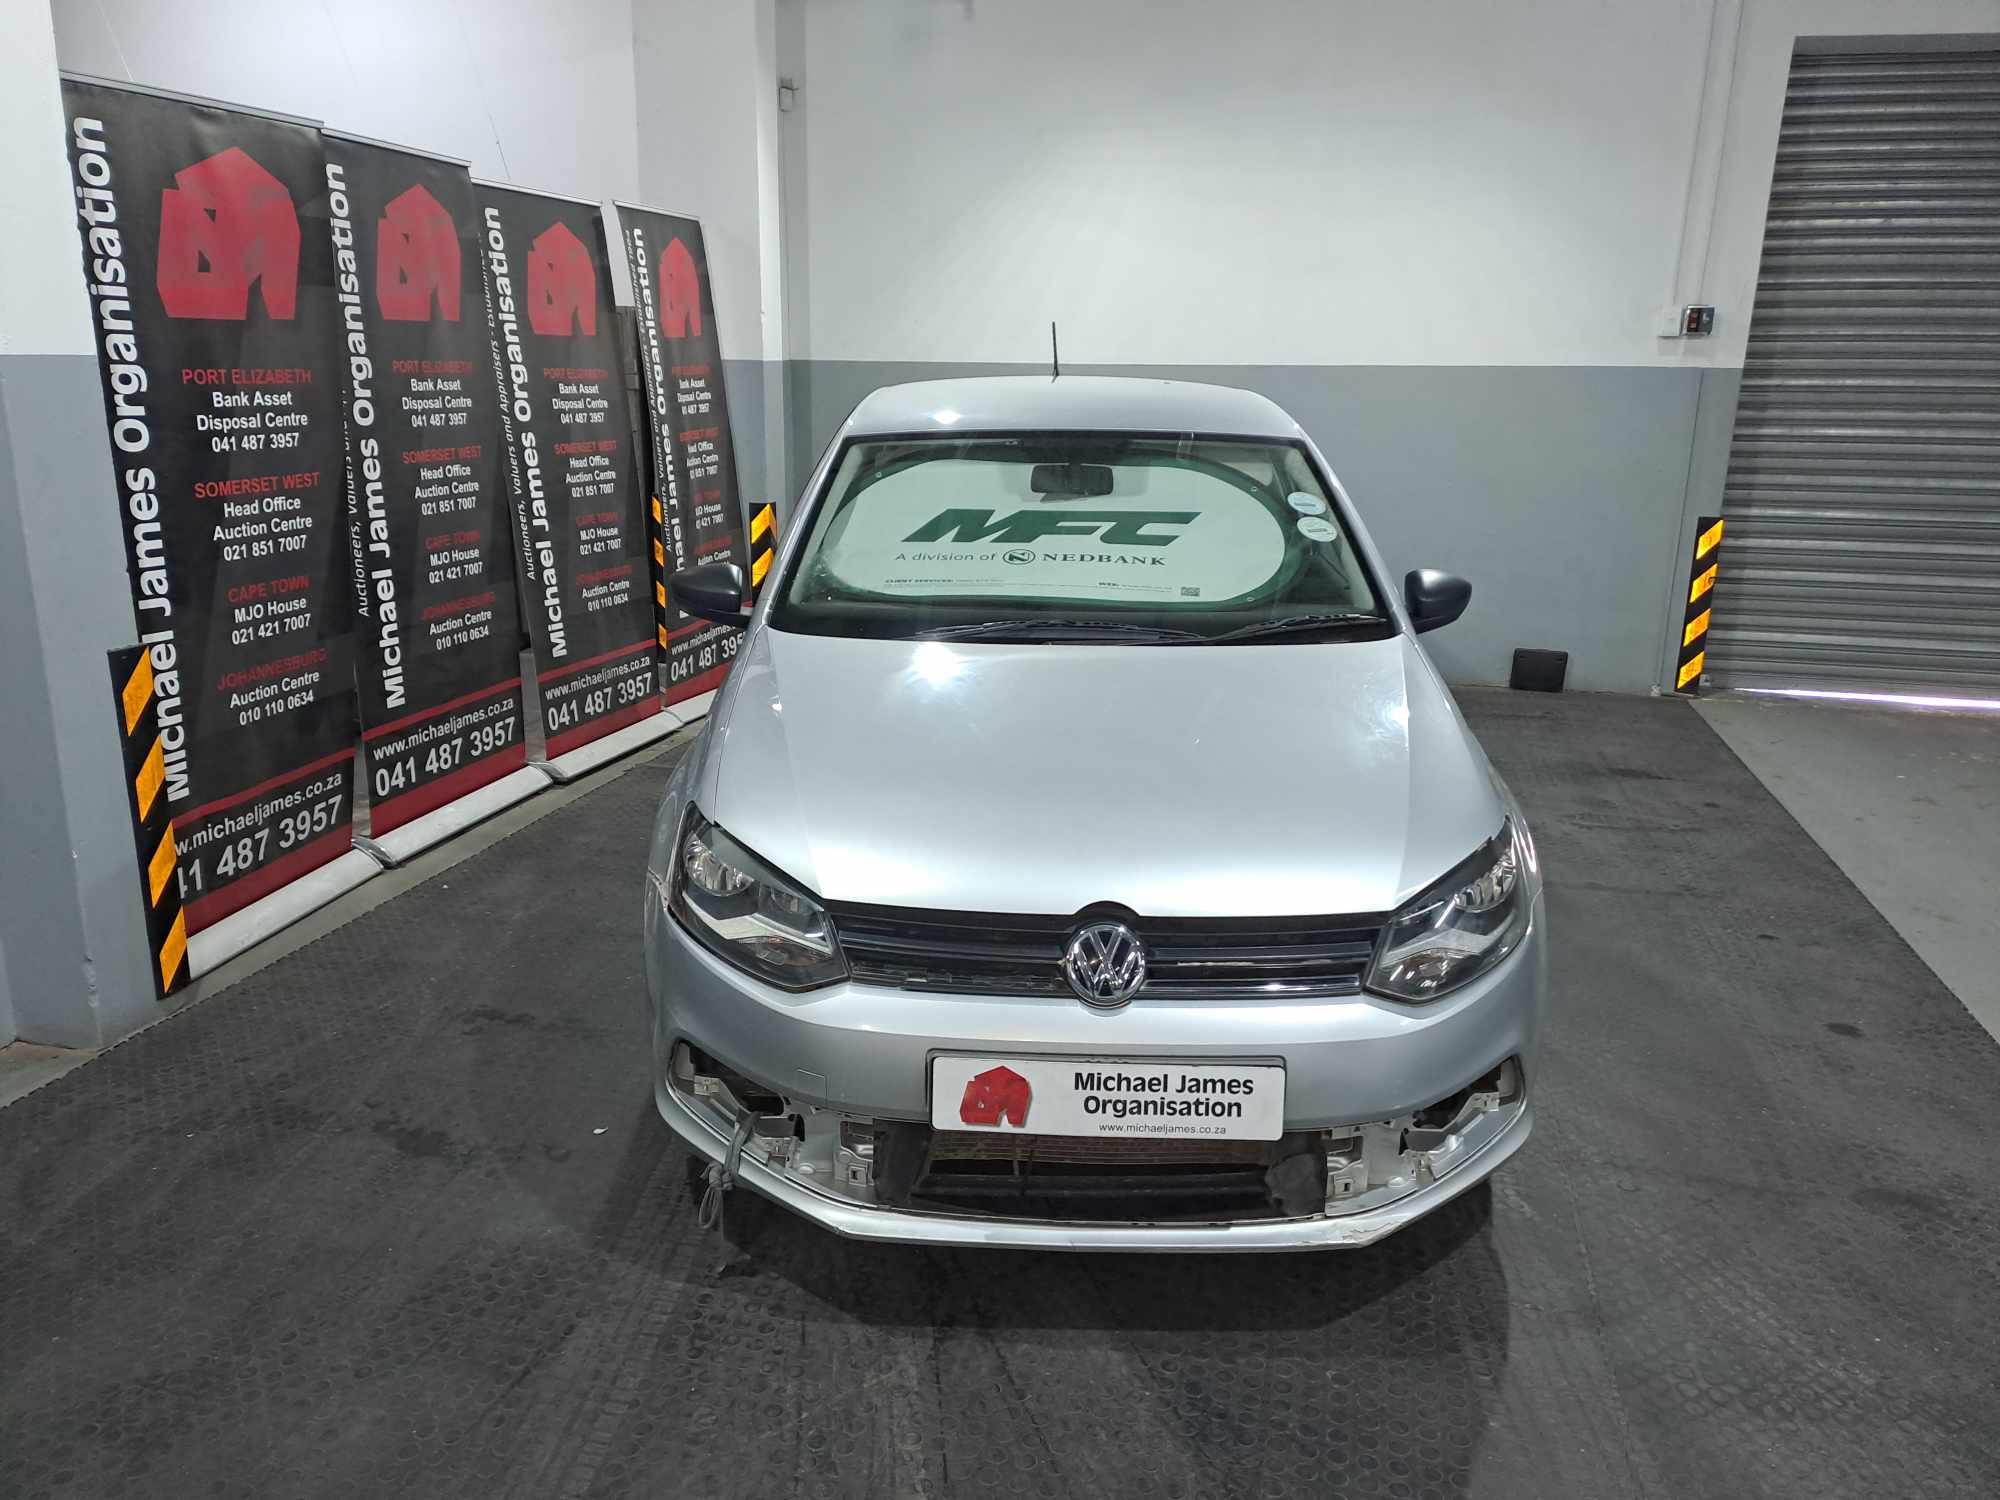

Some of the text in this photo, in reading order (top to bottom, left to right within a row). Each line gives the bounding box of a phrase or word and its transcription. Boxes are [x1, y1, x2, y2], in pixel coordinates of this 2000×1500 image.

[484, 206, 533, 423] Organisation
[182, 368, 312, 384] PORT ELIZABETH
[410, 378, 462, 391] Bank Asset
[212, 391, 293, 408] Bank Asset
[401, 395, 472, 412] Disposal Centre
[196, 412, 309, 433] Disposal Centre
[411, 412, 467, 427] 041 487 3957
[211, 432, 299, 453] 041 487 3957
[326, 162, 406, 710] Michael James Organisation
[73, 116, 190, 803] Michael James Organisation
[420, 464, 471, 480] Head Office
[490, 340, 536, 580] Auctioneers, Valuers and Appraisers
[661, 423, 678, 510] James
[194, 472, 320, 498] SOMERSET WEST
[414, 481, 479, 499] Auction Centre
[521, 431, 550, 532] James
[223, 497, 301, 518] Head Office
[421, 496, 477, 515] 021 851 7007
[213, 515, 313, 541] Auction Centre
[901, 508, 1203, 547] MFC
[223, 534, 307, 561] 021 851 7007
[430, 548, 480, 567] MJO House
[895, 552, 907, 561] A
[911, 551, 974, 561] division
[979, 551, 997, 561] of
[1042, 553, 1167, 566] NEDBANK
[350, 521, 369, 617] Auctioneers,
[428, 561, 483, 584] 021 421 7007
[227, 575, 310, 603] CAPE TOWN
[536, 540, 568, 658] Michael
[233, 596, 307, 624] MJO House
[429, 610, 492, 635] Auction Centre
[231, 613, 311, 645] 021 421 7007
[436, 636, 451, 650] 010
[454, 630, 468, 645] 110
[217, 647, 328, 691] JOHANNESBURG
[671, 631, 747, 681] 041 487 395
[229, 670, 320, 709] Auction Centre
[545, 655, 651, 700] www.michaeljames.co.za
[239, 689, 314, 726] 010 110 0634
[548, 672, 652, 731] 041 487 3957
[372, 697, 514, 761] www.michaeljames.co.za
[375, 716, 516, 798] 041 487 3957
[216, 828, 270, 878] 487
[278, 794, 343, 849] 3957
[1073, 1071, 1255, 1095] Michael James
[1083, 1095, 1243, 1118] Organisation
[1099, 1122, 1227, 1136] www.michaeljames.co.za
